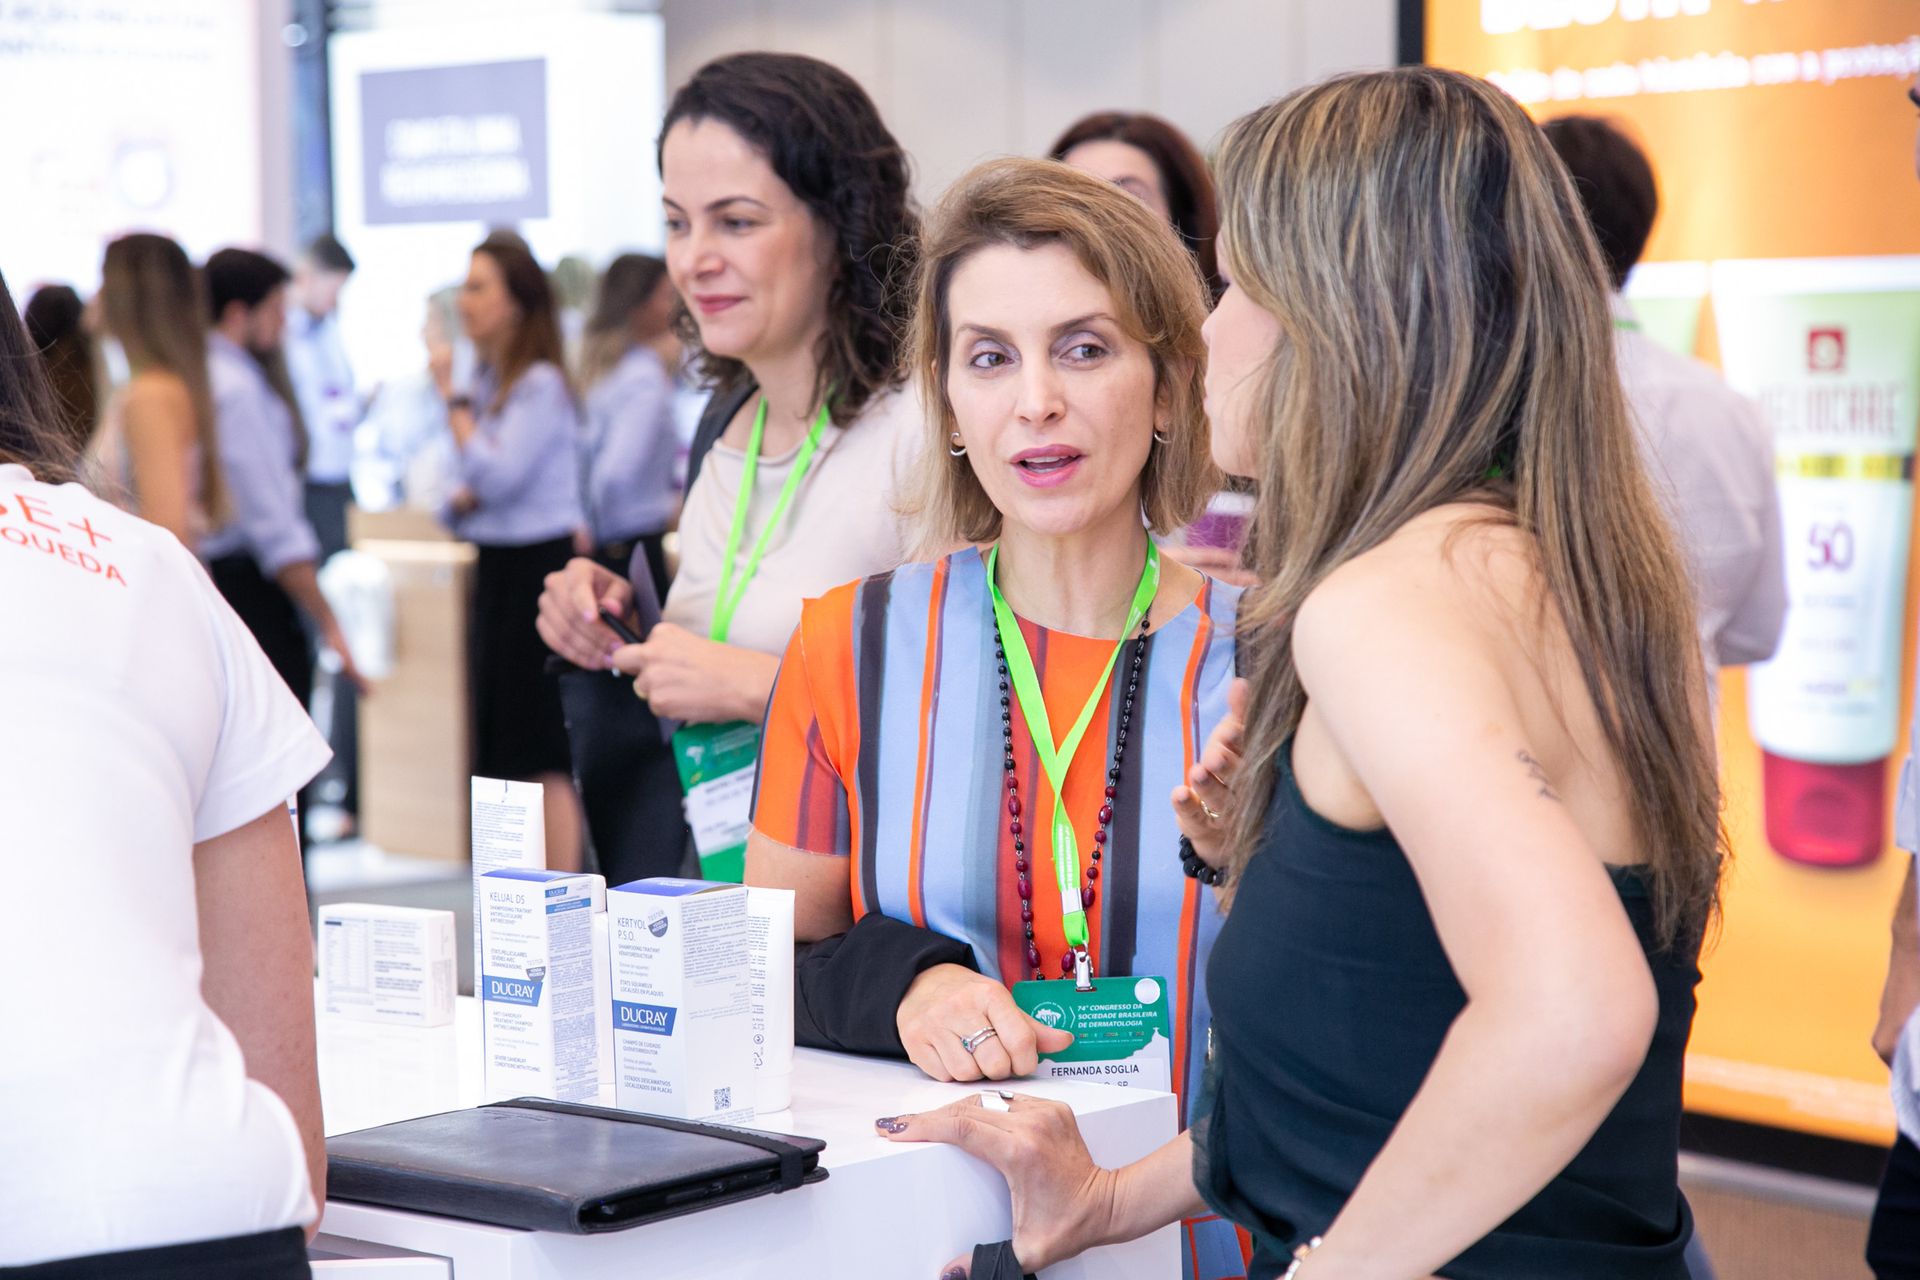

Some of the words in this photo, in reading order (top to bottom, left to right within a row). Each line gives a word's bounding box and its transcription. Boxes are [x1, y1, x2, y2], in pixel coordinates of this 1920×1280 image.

[0, 494, 112, 548] E+
[490, 892, 514, 903] KELUAL
[515, 894, 525, 905] DS
[617, 918, 647, 930] KERTYOL
[618, 930, 635, 941] P.S.O.
[491, 981, 535, 999] DUCRAY
[1089, 1003, 1132, 1011] CONGRESSO
[620, 1006, 668, 1026] DUCRAY
[1077, 1012, 1117, 1020] SOCIEDADE
[1118, 1011, 1158, 1019] BRASILEIRA
[1077, 1021, 1088, 1029] DE
[1088, 1020, 1143, 1028] DERMATOLOGIA
[1051, 1066, 1102, 1077] FERNANDA
[1104, 1064, 1140, 1074] SOGLIA
